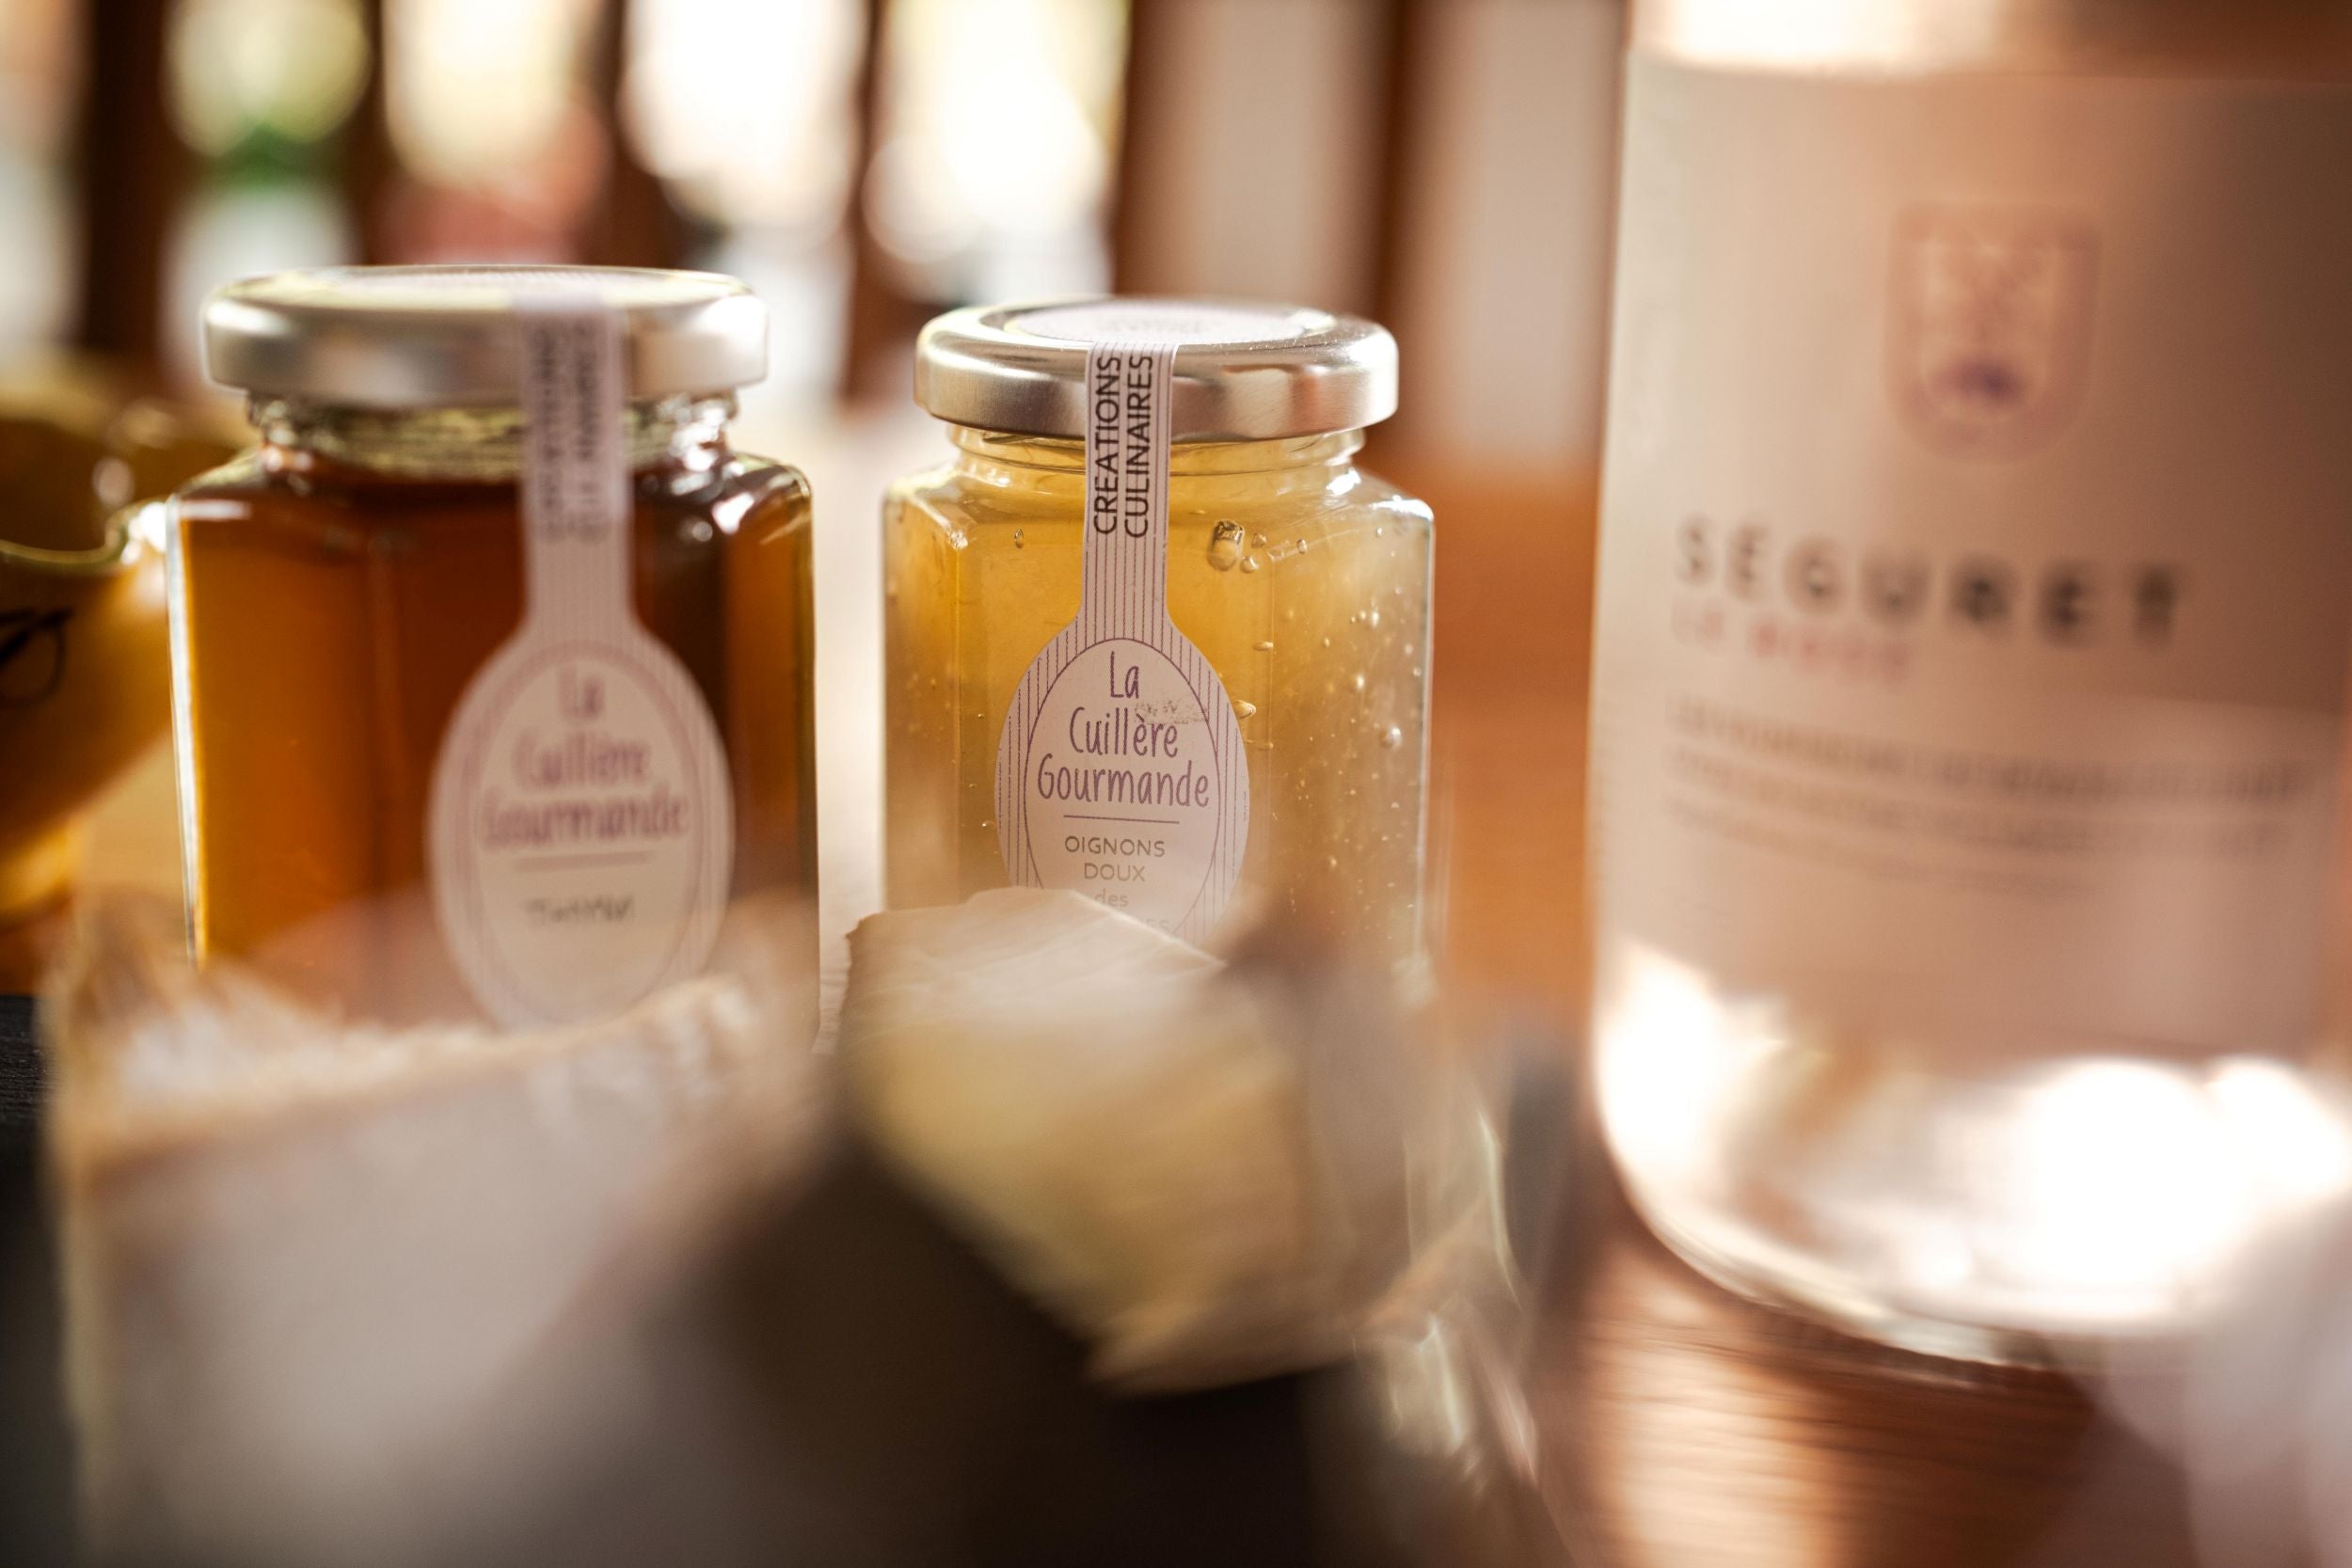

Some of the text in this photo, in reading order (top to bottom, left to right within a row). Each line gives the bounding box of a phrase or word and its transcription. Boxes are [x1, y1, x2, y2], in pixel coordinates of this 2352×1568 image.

[1094, 356, 1121, 535] CREATIONS
[1124, 356, 1152, 538] CULINAIRES
[1110, 650, 1139, 699] La
[1069, 706, 1178, 757] Cuillère
[1037, 752, 1209, 808] Gourmande
[1064, 835, 1166, 858] OIGNONS
[1083, 863, 1146, 883] DOUX
